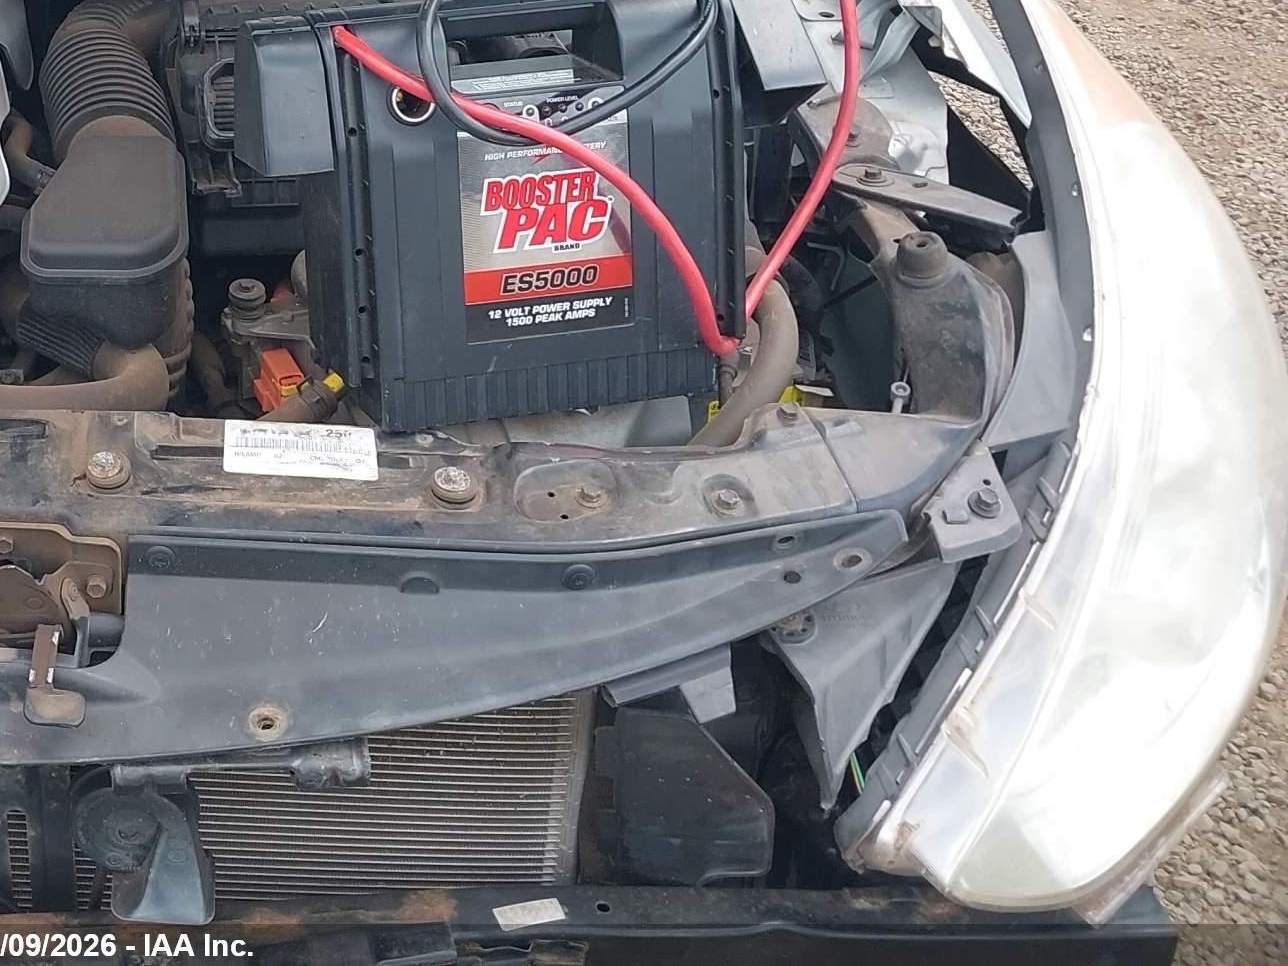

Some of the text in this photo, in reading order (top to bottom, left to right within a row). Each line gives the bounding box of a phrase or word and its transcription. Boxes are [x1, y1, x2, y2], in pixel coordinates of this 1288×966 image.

[484, 152, 505, 161] HIGH
[506, 145, 563, 158] PERFORMAN
[482, 169, 597, 213] BOOSTER
[496, 198, 610, 251] PAC
[554, 242, 581, 251] BRAND
[500, 264, 600, 295] ES5000
[488, 310, 502, 319] 12
[504, 306, 531, 318] VOLT
[532, 302, 570, 315] POWER
[572, 296, 613, 310] SUPPLY
[505, 308, 596, 327] 1500 PEAK AMPS
